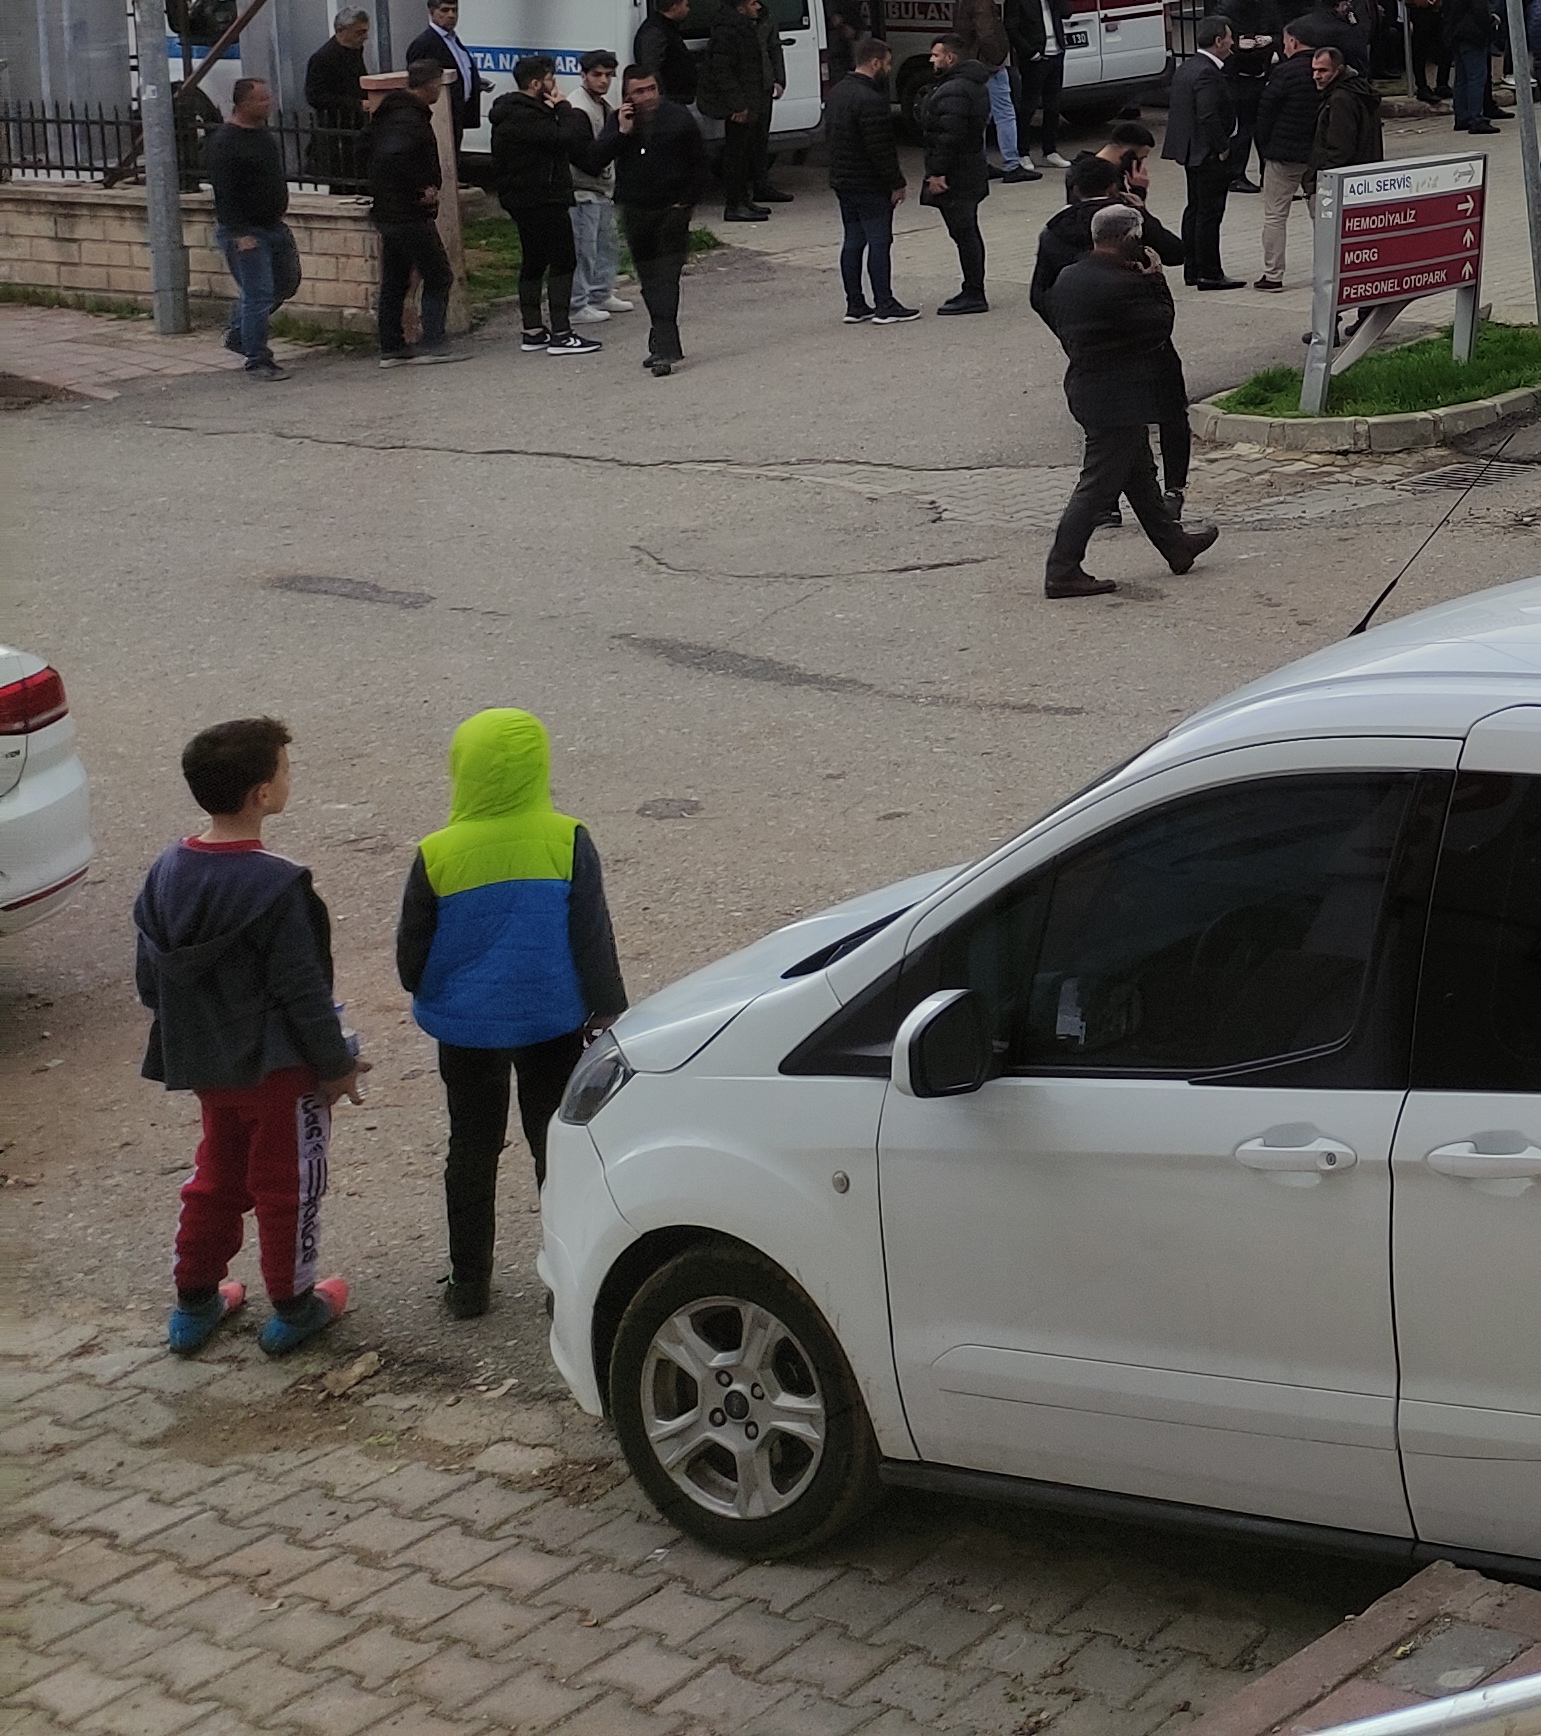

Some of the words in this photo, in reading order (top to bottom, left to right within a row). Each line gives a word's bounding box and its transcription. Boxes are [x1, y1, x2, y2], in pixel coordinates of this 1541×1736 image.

[1349, 179, 1373, 196] ACİL
[1375, 174, 1412, 192] SERVİS
[1345, 207, 1416, 232] HEMODİYALİZ
[1344, 248, 1379, 265] MORG
[1342, 279, 1400, 299] PERSONEL
[1402, 269, 1448, 290] OTOPARK
